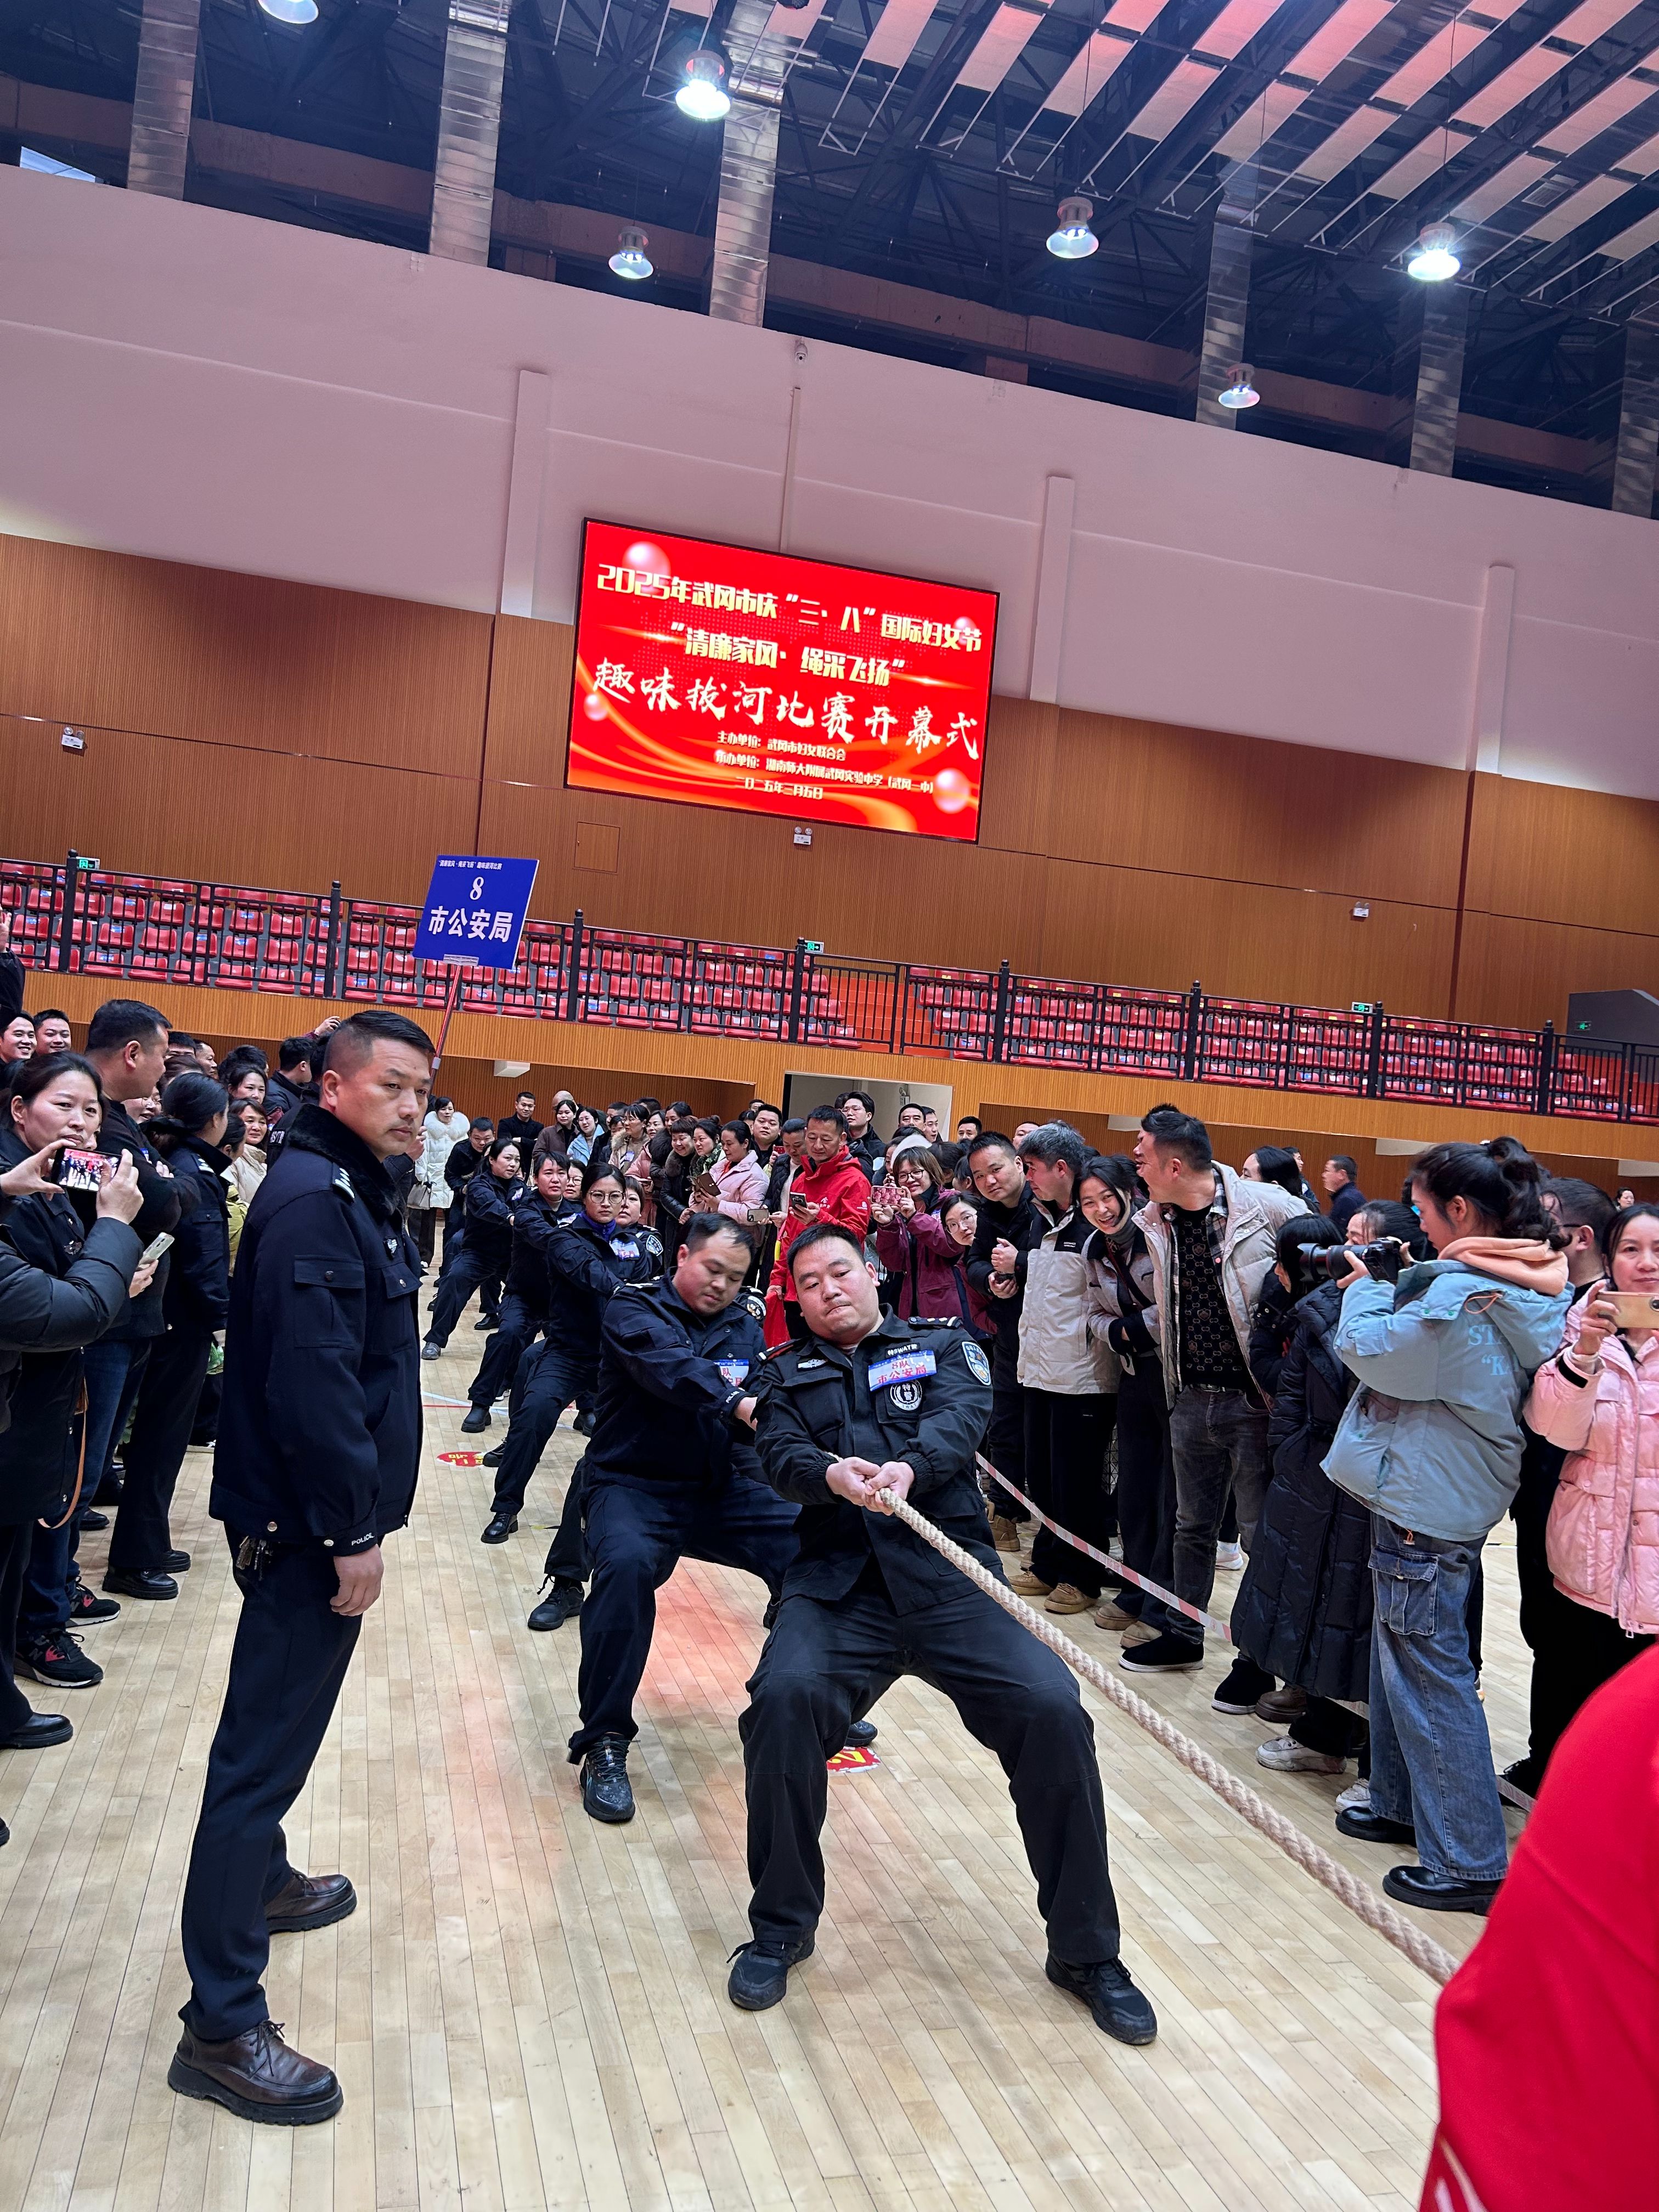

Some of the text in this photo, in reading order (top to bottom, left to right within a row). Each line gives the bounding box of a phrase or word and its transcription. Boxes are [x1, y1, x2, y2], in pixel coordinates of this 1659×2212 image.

[592, 657, 979, 760] 趣味拔河比赛开幕式
[470, 876, 484, 900] 8
[428, 905, 514, 943] 市公安局
[1468, 1324, 1502, 1345] ST
[877, 1364, 927, 1384] 市公安局
[351, 1532, 375, 1546] POLICE
